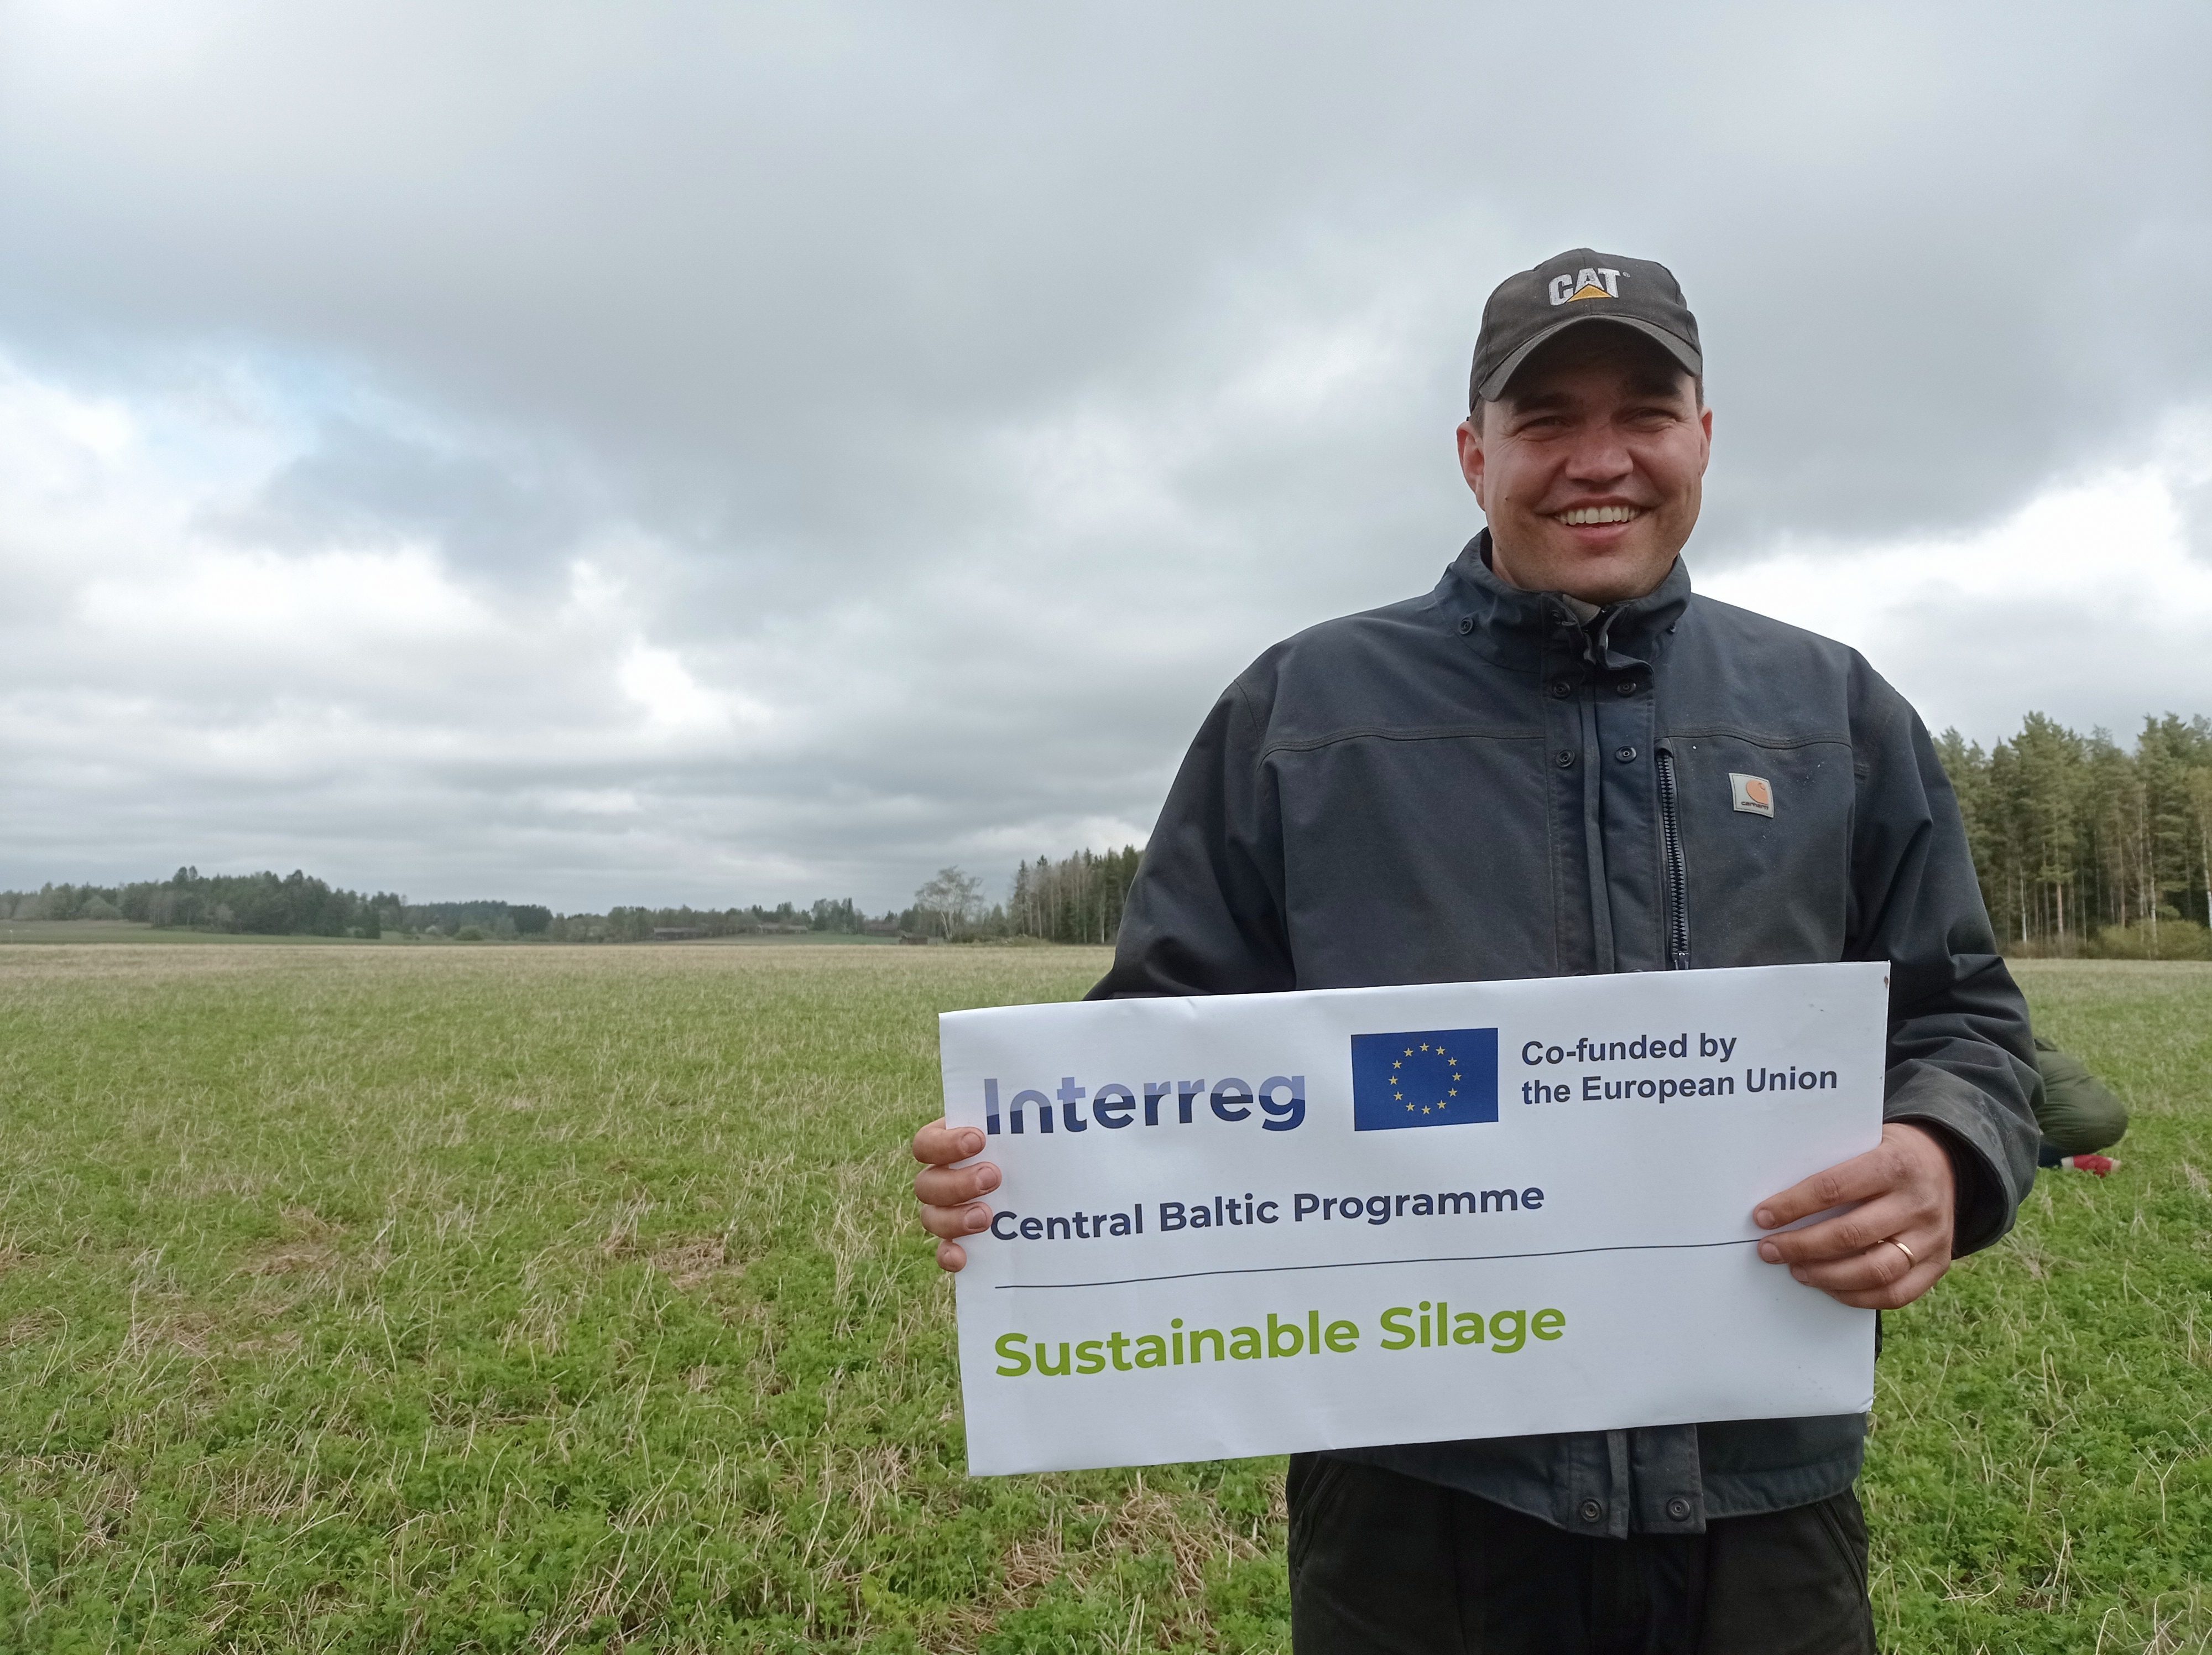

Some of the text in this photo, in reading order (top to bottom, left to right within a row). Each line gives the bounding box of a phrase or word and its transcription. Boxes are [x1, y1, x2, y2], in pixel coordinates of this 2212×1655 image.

[1549, 268, 1621, 305] CAT
[1521, 1033, 1737, 1065] Co-funded by
[984, 1075, 1306, 1134] Interreg
[1521, 1066, 1838, 1105] the European Union
[991, 1187, 1545, 1241] Central Baltic Programme
[995, 1302, 1566, 1377] Sustainable Silage
